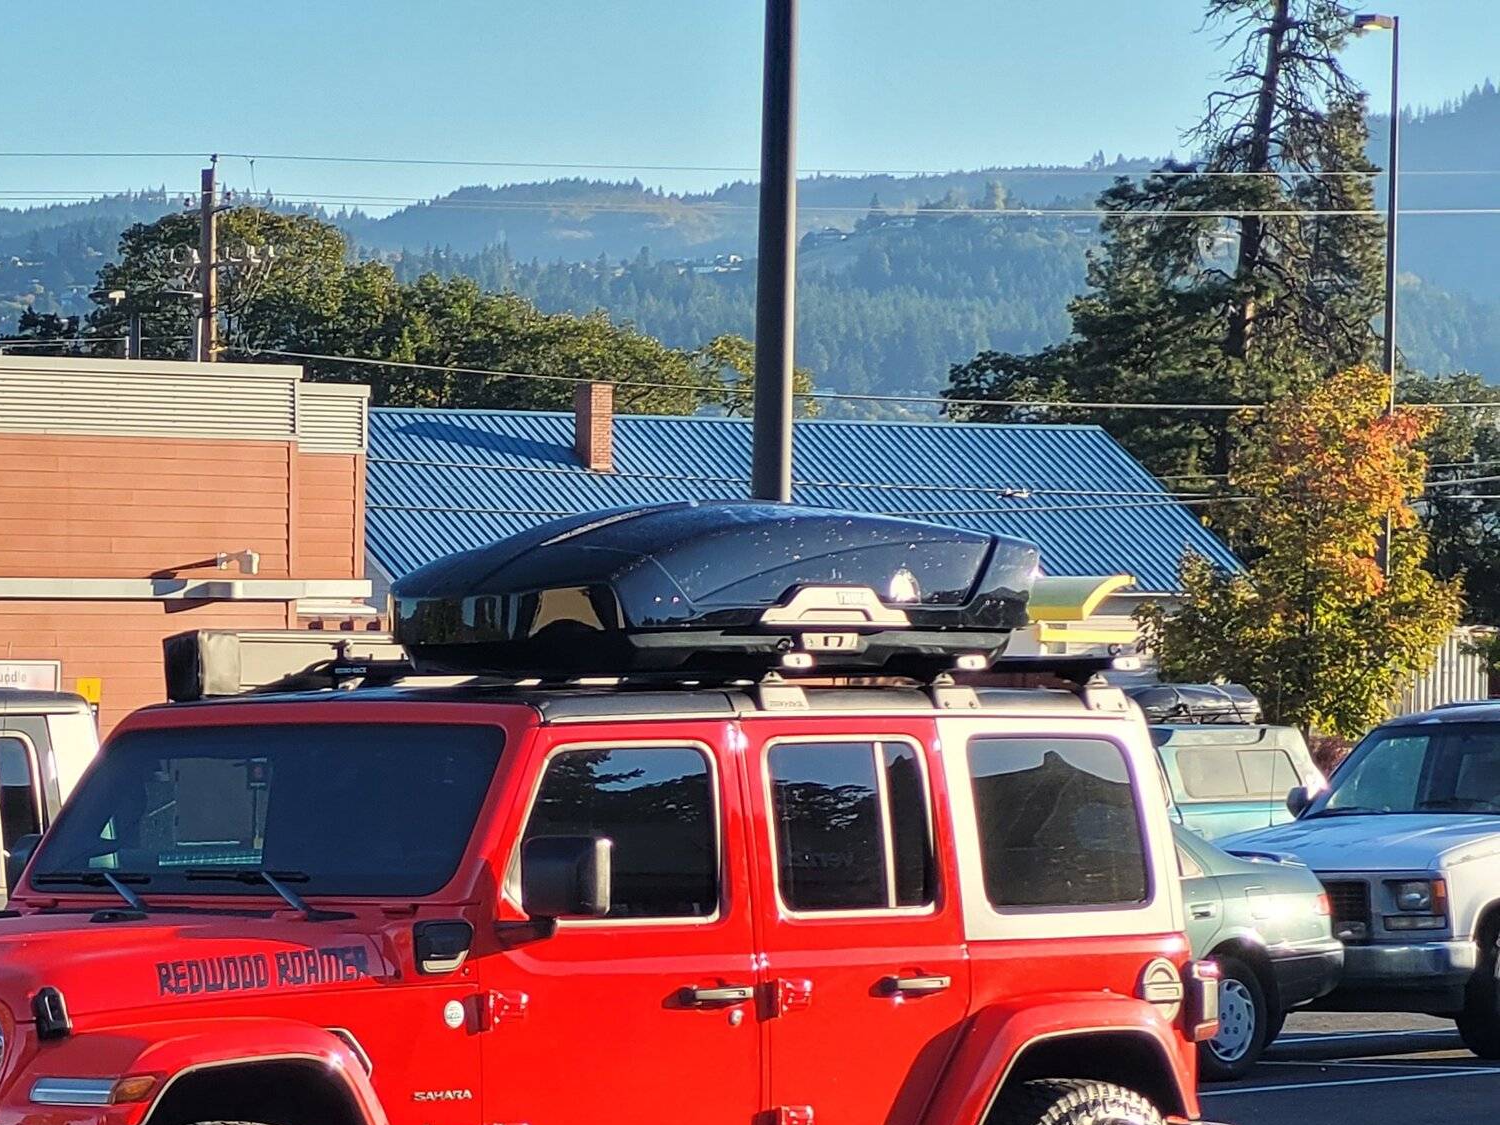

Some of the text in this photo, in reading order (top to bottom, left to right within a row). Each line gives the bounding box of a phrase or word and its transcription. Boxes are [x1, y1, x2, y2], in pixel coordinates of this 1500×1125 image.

[156, 946, 368, 996] REDWOOD ROAMER
[413, 1089, 473, 1101] SAHARA
